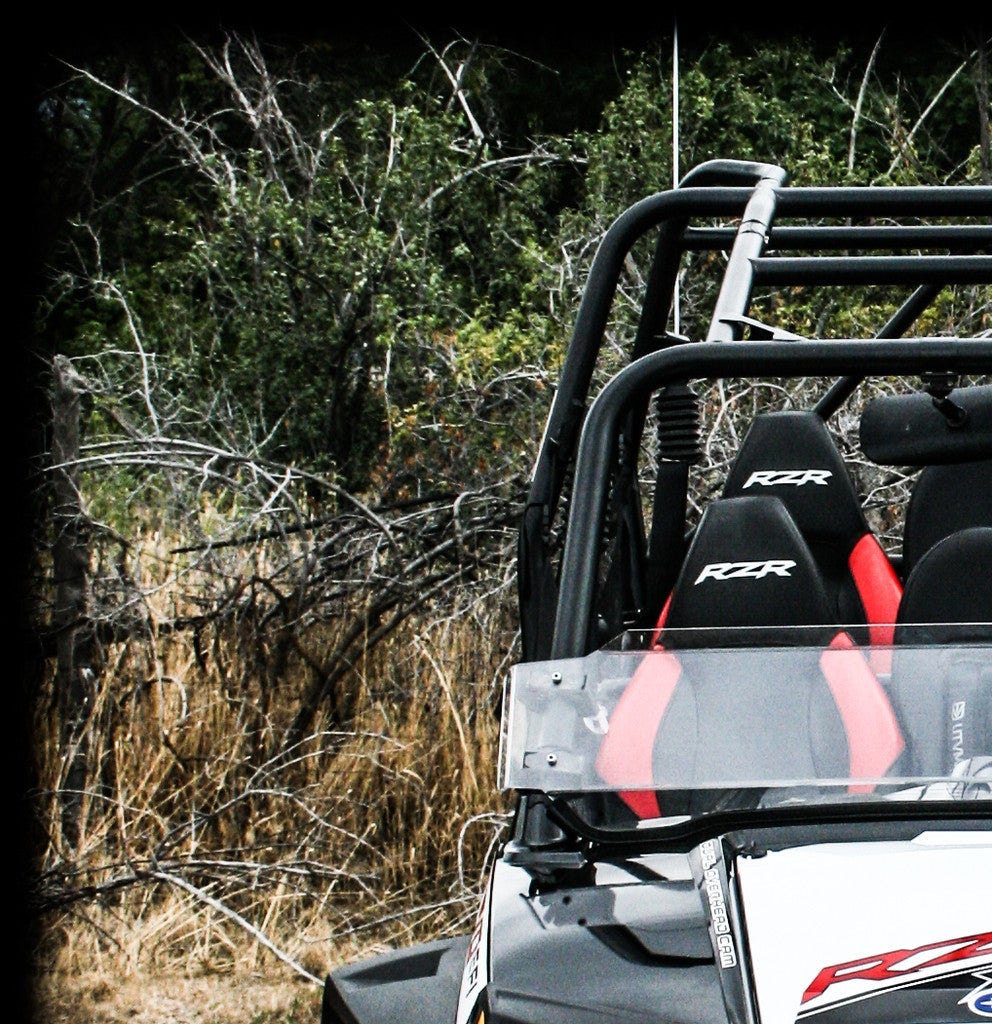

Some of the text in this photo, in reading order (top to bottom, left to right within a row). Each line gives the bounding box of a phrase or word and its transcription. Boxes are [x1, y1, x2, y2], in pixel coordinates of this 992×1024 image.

[742, 469, 833, 489] RZR
[694, 559, 797, 586] RZR
[704, 868, 730, 934] OVERHEAD
[717, 934, 737, 968] CAM
